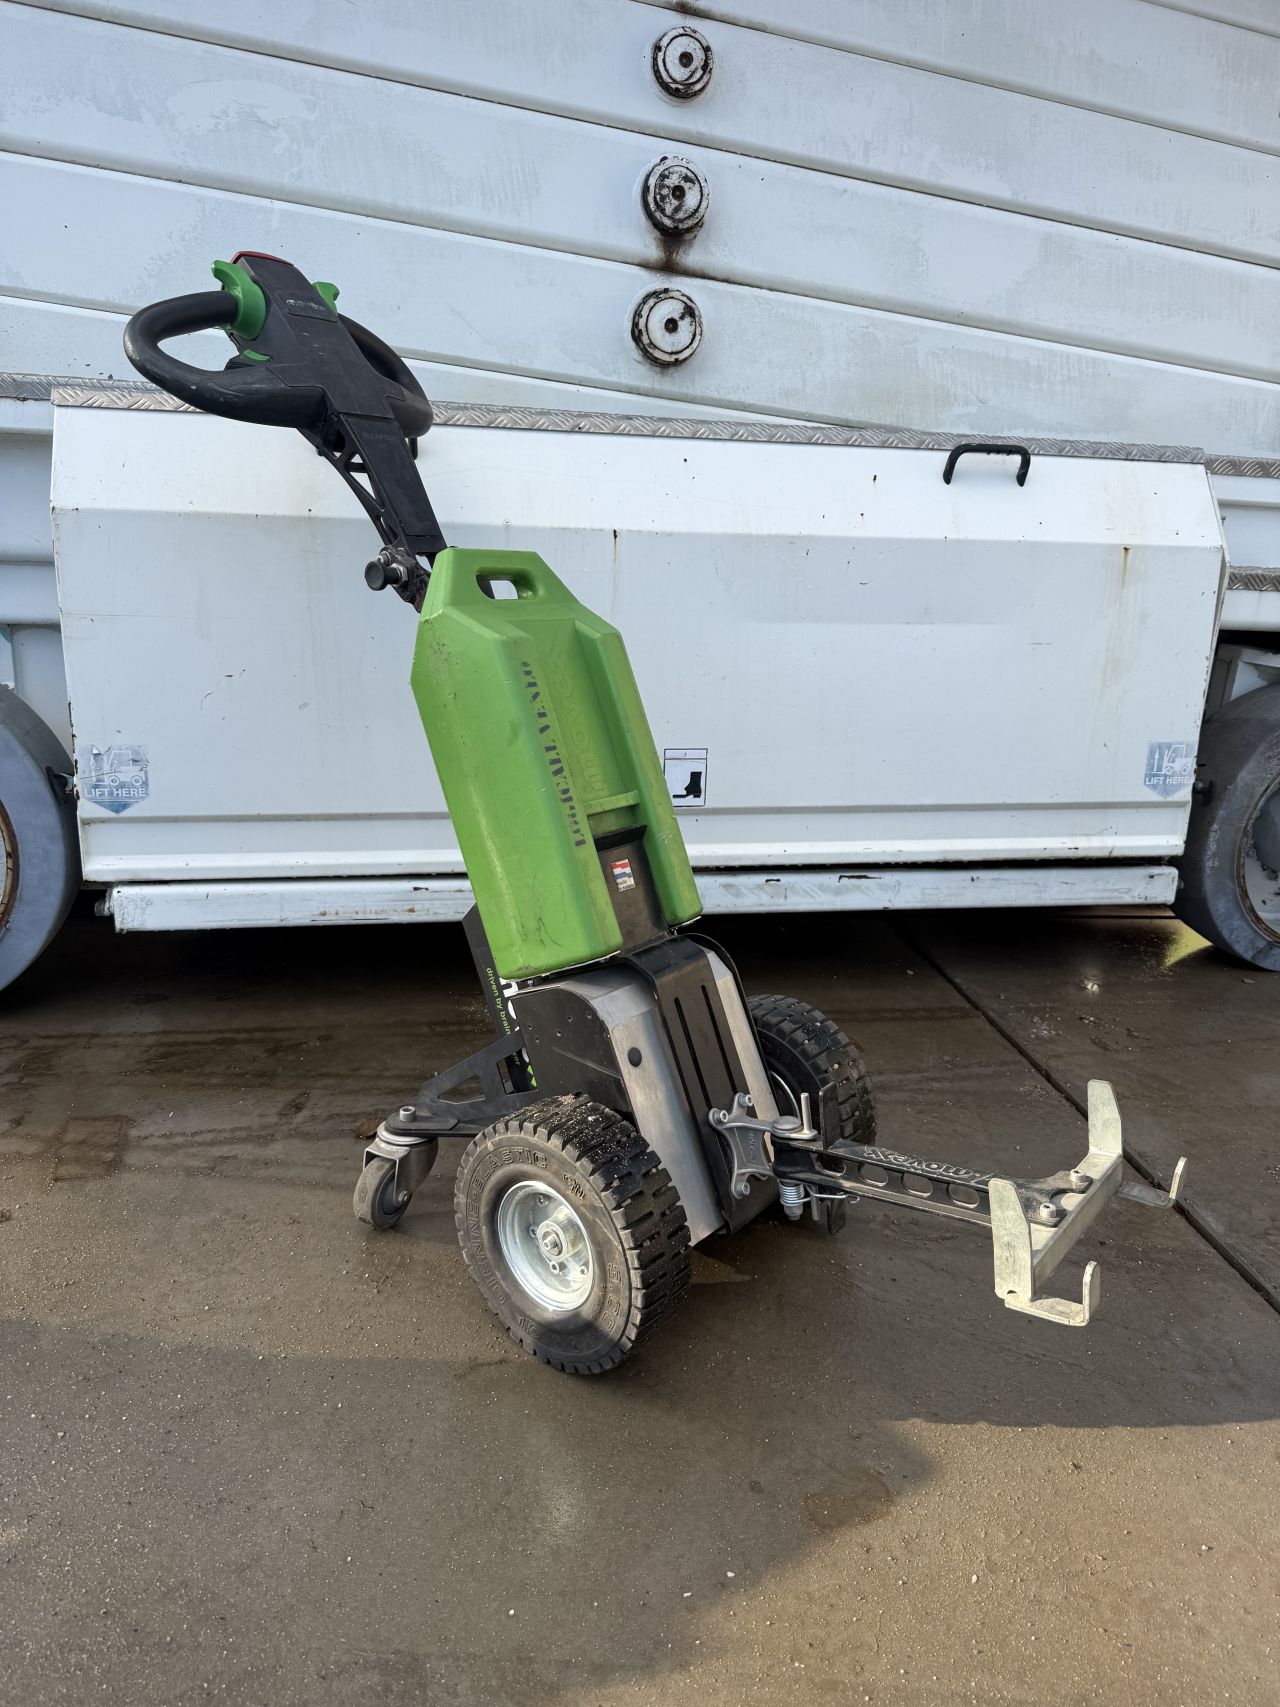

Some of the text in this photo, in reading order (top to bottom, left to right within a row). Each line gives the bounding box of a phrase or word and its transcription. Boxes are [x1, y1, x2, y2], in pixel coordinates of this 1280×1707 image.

[1146, 776, 1190, 785] LIFT HERE
[85, 788, 146, 797] LIFT HERE
[486, 967, 498, 994] driven
[495, 997, 503, 1009] by
[500, 1010, 511, 1035] brain
